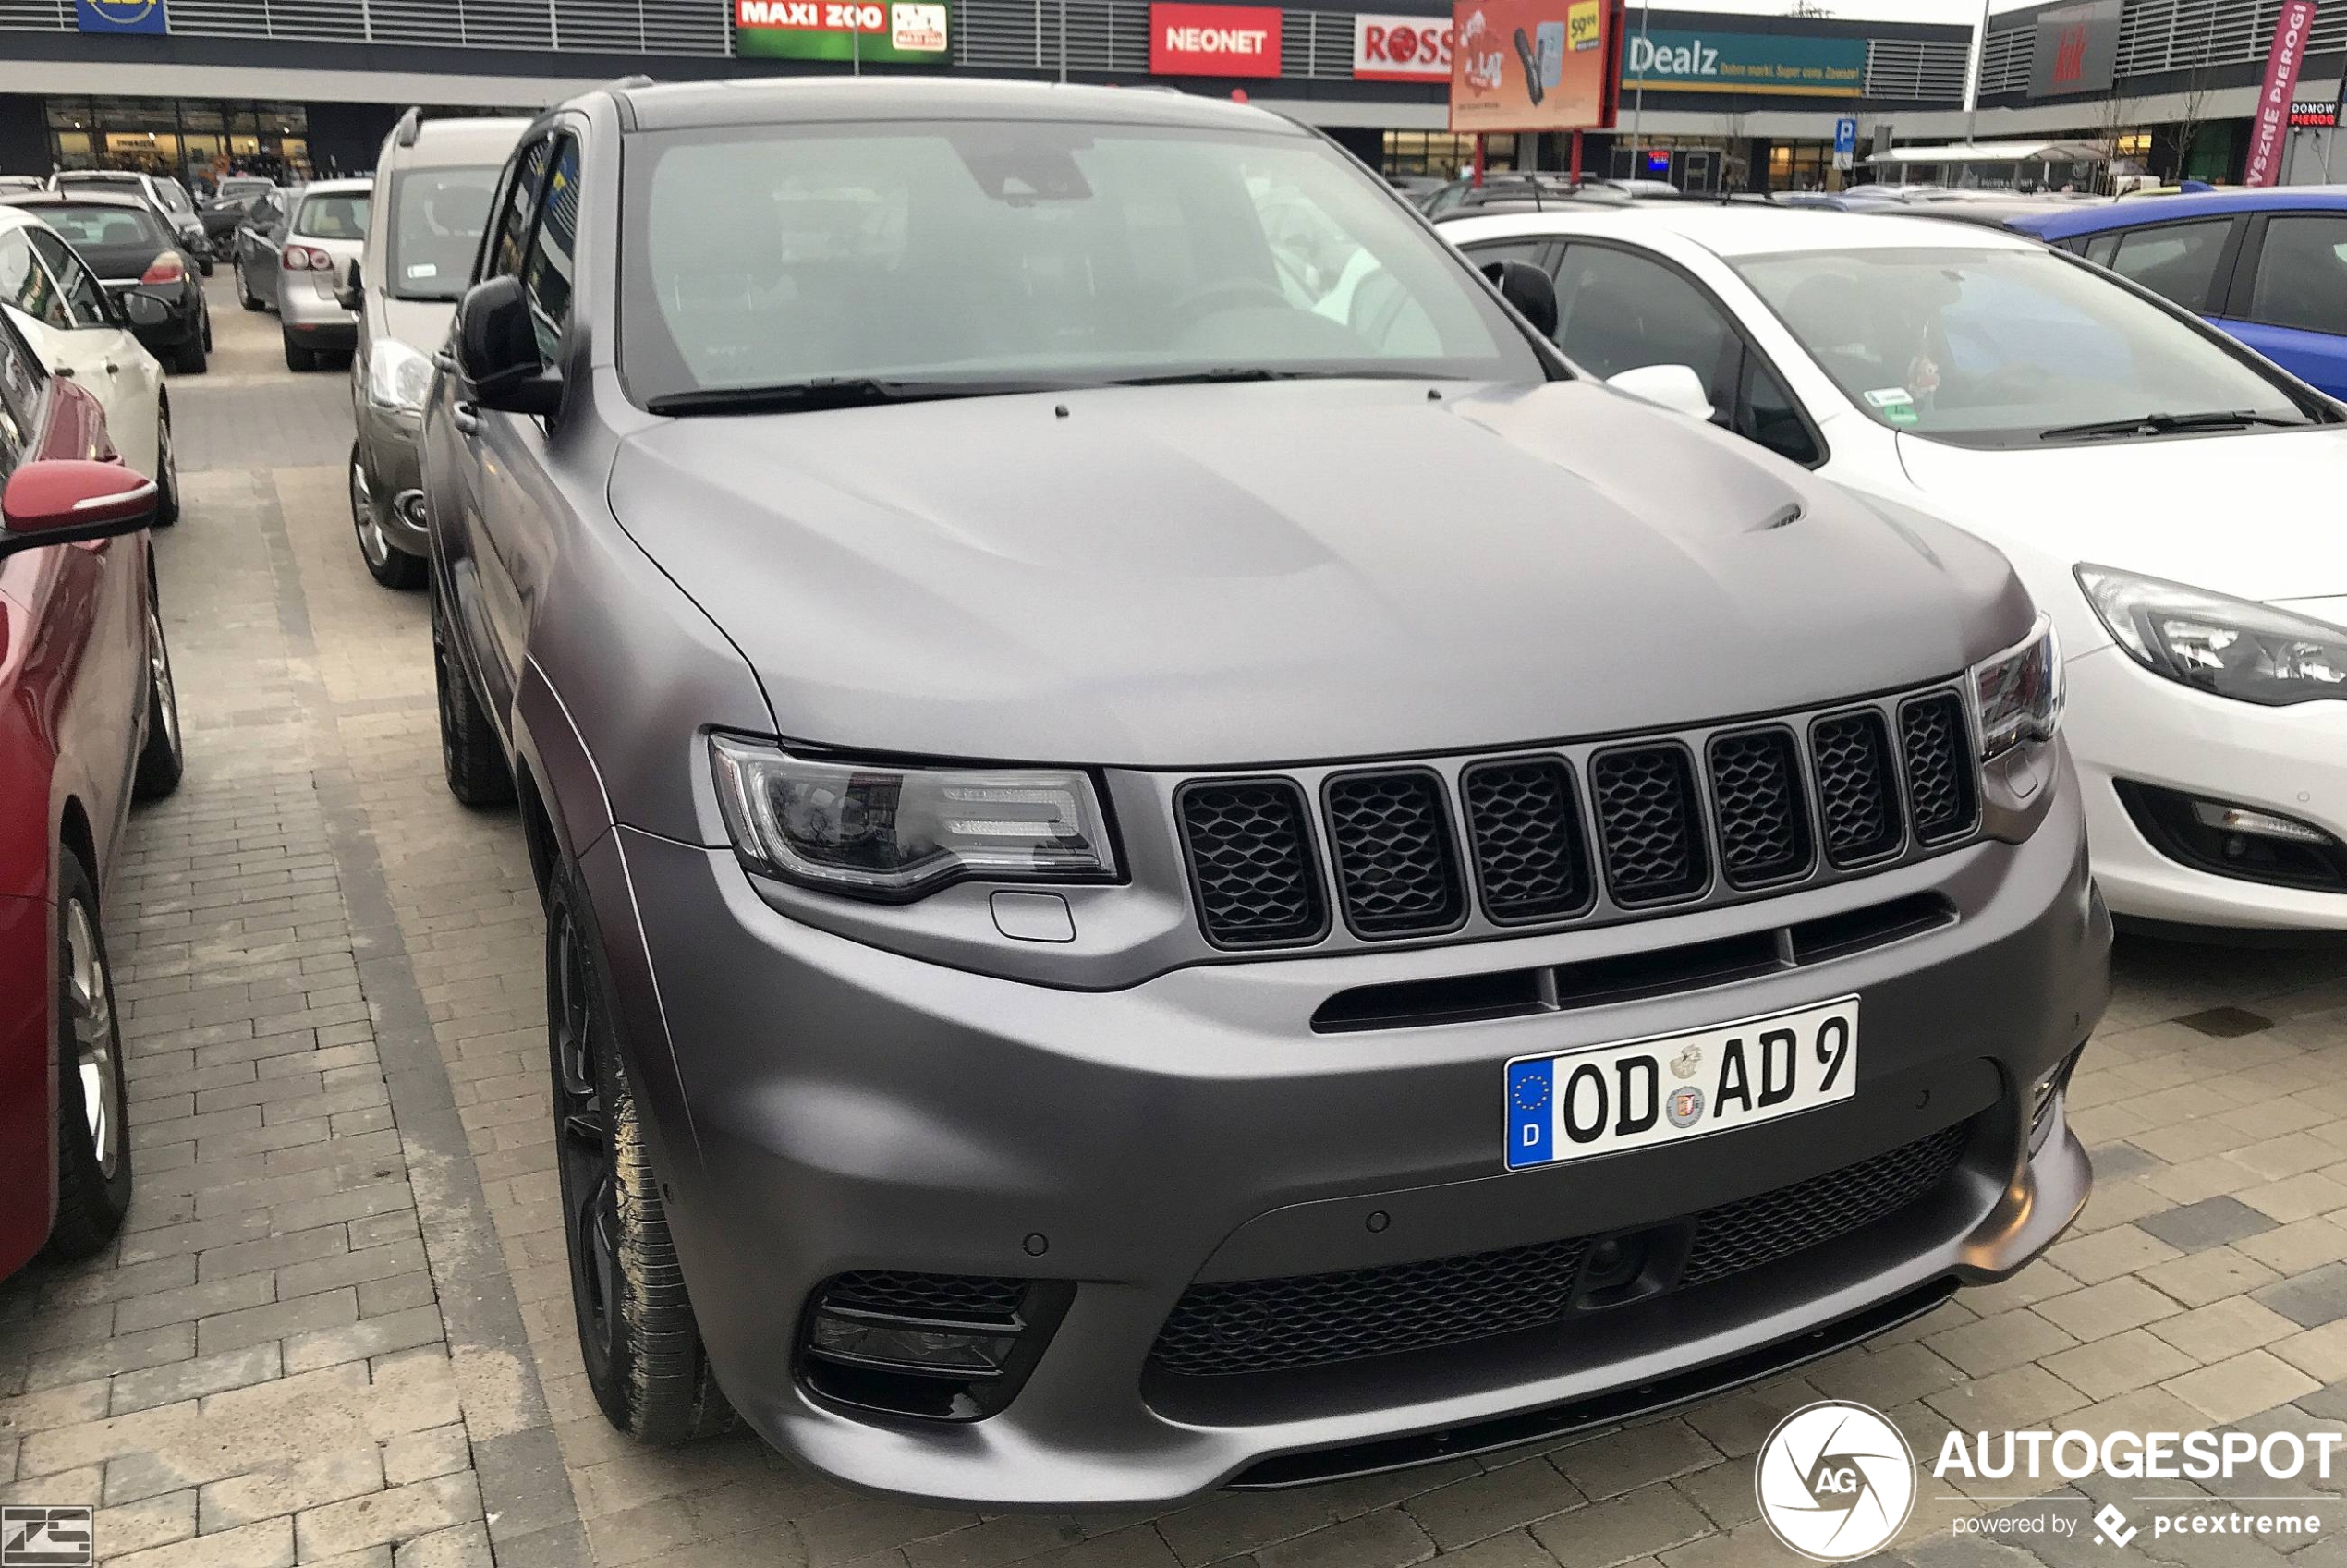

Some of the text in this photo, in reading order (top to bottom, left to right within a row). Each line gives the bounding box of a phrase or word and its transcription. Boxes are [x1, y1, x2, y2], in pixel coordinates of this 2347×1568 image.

[741, 1, 882, 29] MAXI ZOO
[1166, 26, 1267, 54] NEONET
[2269, 4, 2307, 103] PIEROGI
[1629, 36, 1719, 75] Dealz
[1840, 121, 1854, 143] P
[2292, 114, 2335, 125] PIEROG
[1563, 1054, 1660, 1144] OD
[1713, 1027, 1797, 1118] AD
[1815, 1015, 1849, 1092] 9
[1523, 1123, 1540, 1148] D
